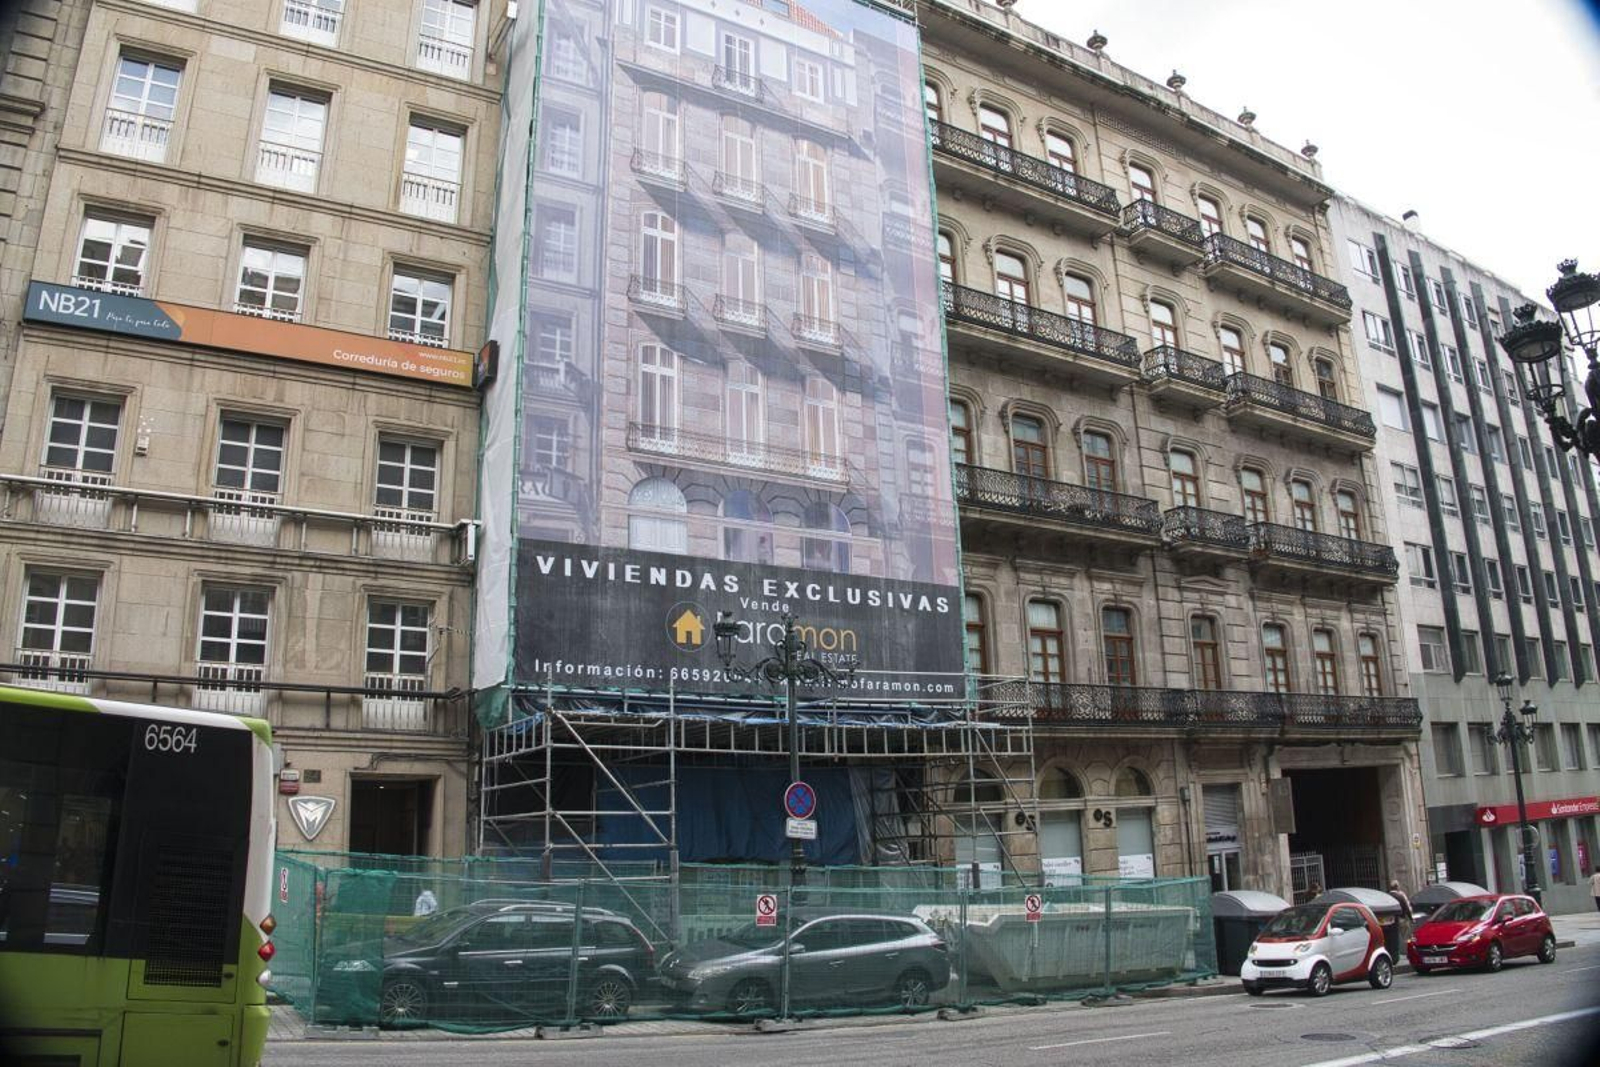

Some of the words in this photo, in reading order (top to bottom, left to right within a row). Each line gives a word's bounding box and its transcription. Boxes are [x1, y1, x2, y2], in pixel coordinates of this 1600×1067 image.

[39, 290, 101, 319] NB21
[333, 349, 398, 369] Correduría
[401, 359, 417, 373] de
[420, 364, 466, 379] seguros
[536, 555, 739, 593] VIVIENDAS
[763, 579, 949, 613] EXCLUSIVAS
[740, 596, 790, 613] Vende
[535, 659, 663, 680] Información:
[821, 651, 857, 665] ESTATE
[145, 724, 198, 753] 6564
